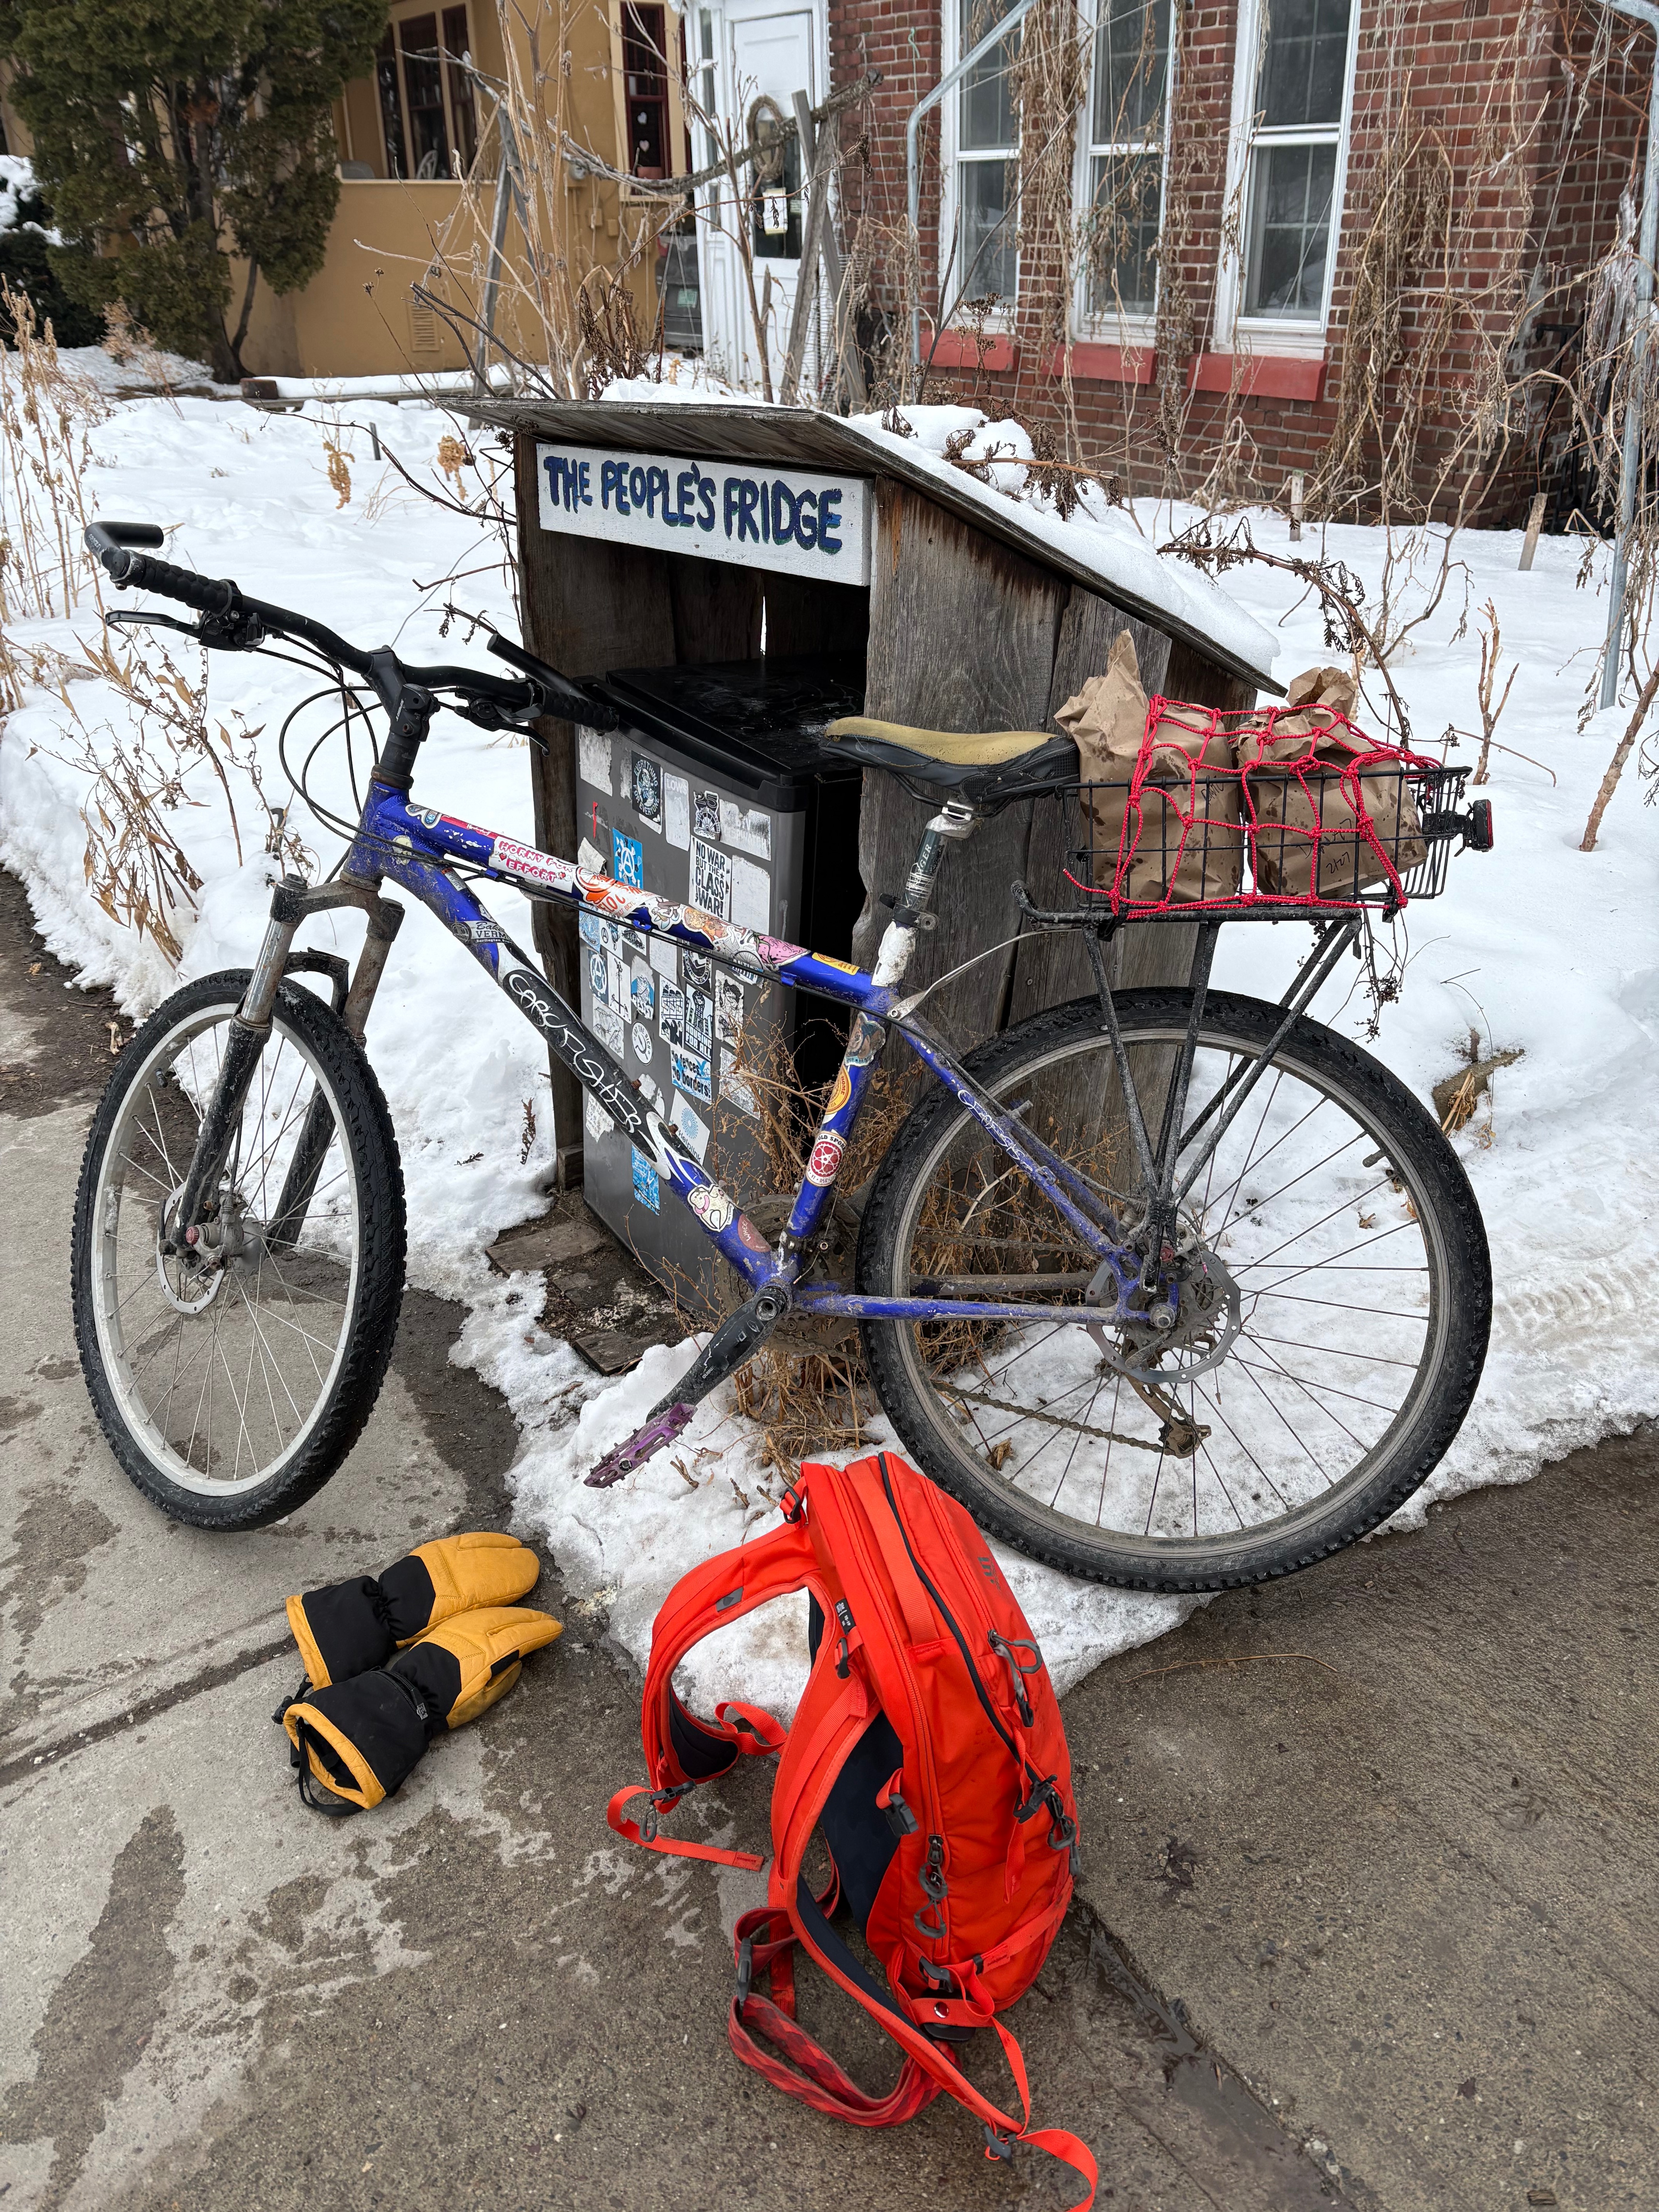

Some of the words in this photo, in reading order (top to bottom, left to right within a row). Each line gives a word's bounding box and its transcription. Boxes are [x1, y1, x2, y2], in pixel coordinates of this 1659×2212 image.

[543, 456, 593, 514] THE
[601, 460, 716, 533] PEOPLE'S
[723, 477, 843, 555] FRIDGE
[634, 759, 658, 787] EVERYTHING
[639, 795, 659, 816] EVERYONE
[695, 792, 718, 808] 25
[498, 841, 544, 862] HORNY
[546, 857, 573, 872] FOR
[506, 858, 556, 883] EFFORT
[696, 841, 706, 859] NO
[707, 847, 725, 872] WAR
[696, 856, 707, 870] BUT
[708, 864, 720, 877] THE
[696, 866, 724, 900] CLASS
[698, 887, 724, 919] WAR!
[685, 1034, 698, 1049] FOR
[700, 1044, 712, 1059] ALL
[686, 1023, 712, 1048] HOUSING
[509, 974, 568, 1029] GARY
[559, 1027, 642, 1133] FISHER
[682, 1069, 711, 1098] borders!
[678, 1129, 702, 1163] Helplink
